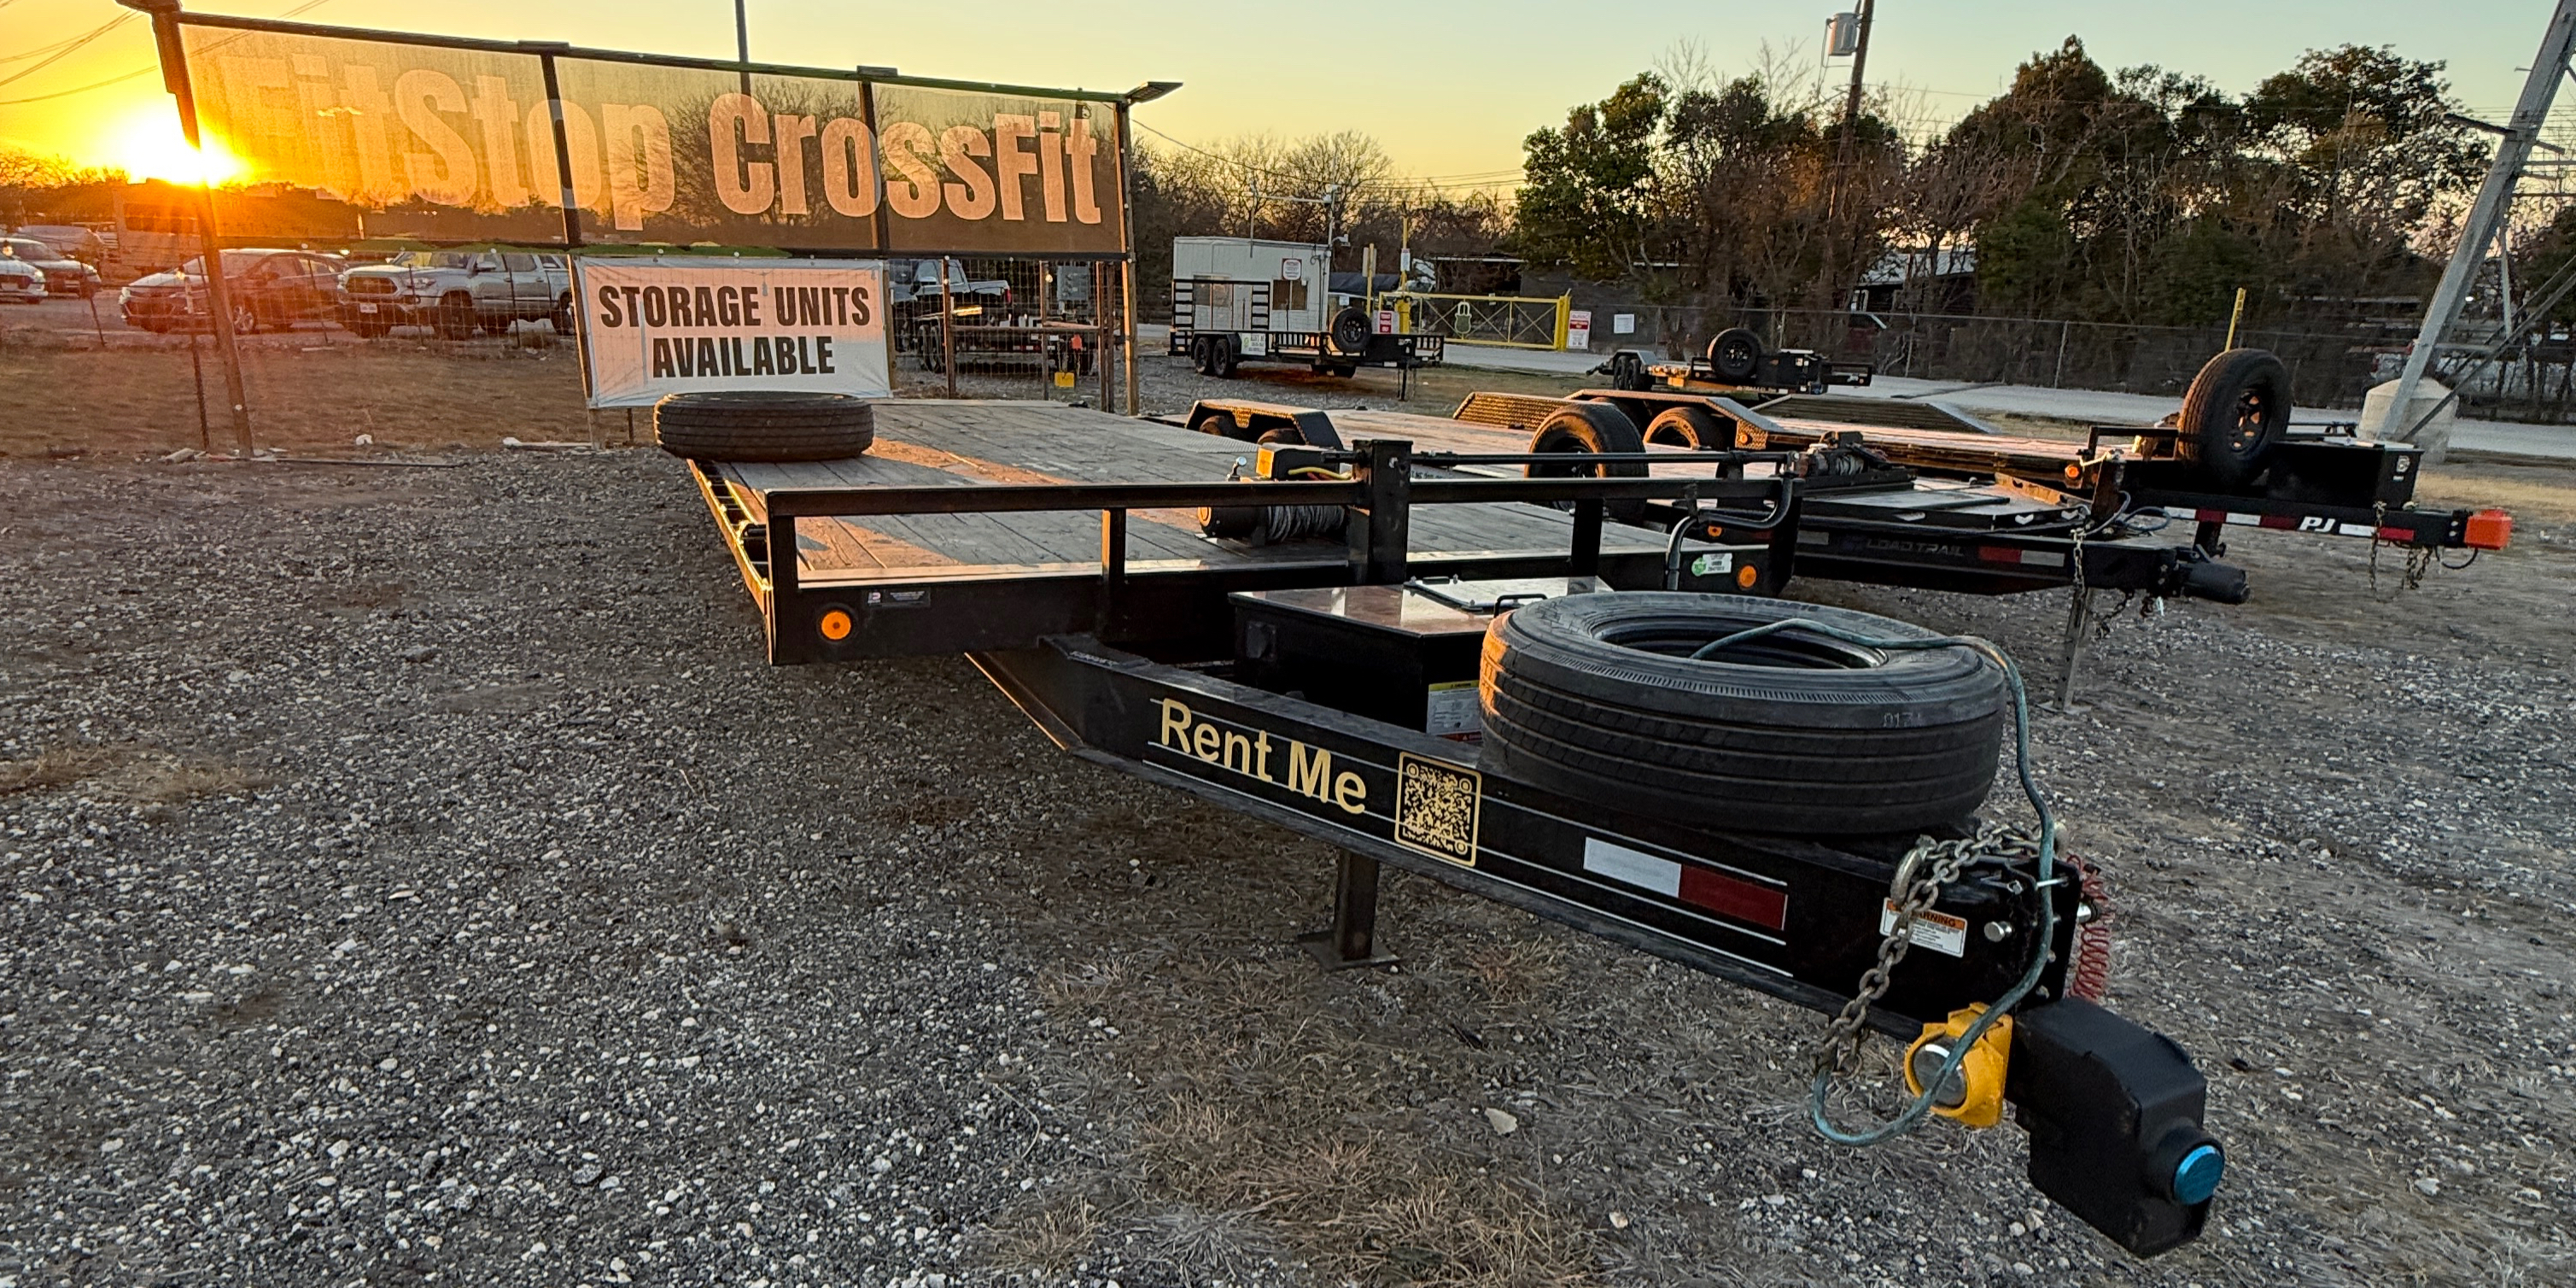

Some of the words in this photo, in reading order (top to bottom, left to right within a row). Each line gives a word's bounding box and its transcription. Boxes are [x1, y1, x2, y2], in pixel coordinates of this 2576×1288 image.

[217, 53, 675, 231] FitStop
[710, 92, 1101, 224] CrossFit
[599, 285, 762, 327] STORAGE
[774, 286, 871, 326] UNITS
[652, 336, 836, 378] AVAILABLE
[2299, 516, 2336, 533] PJ
[1161, 698, 1273, 782] Rent
[1288, 740, 1366, 814] Me
